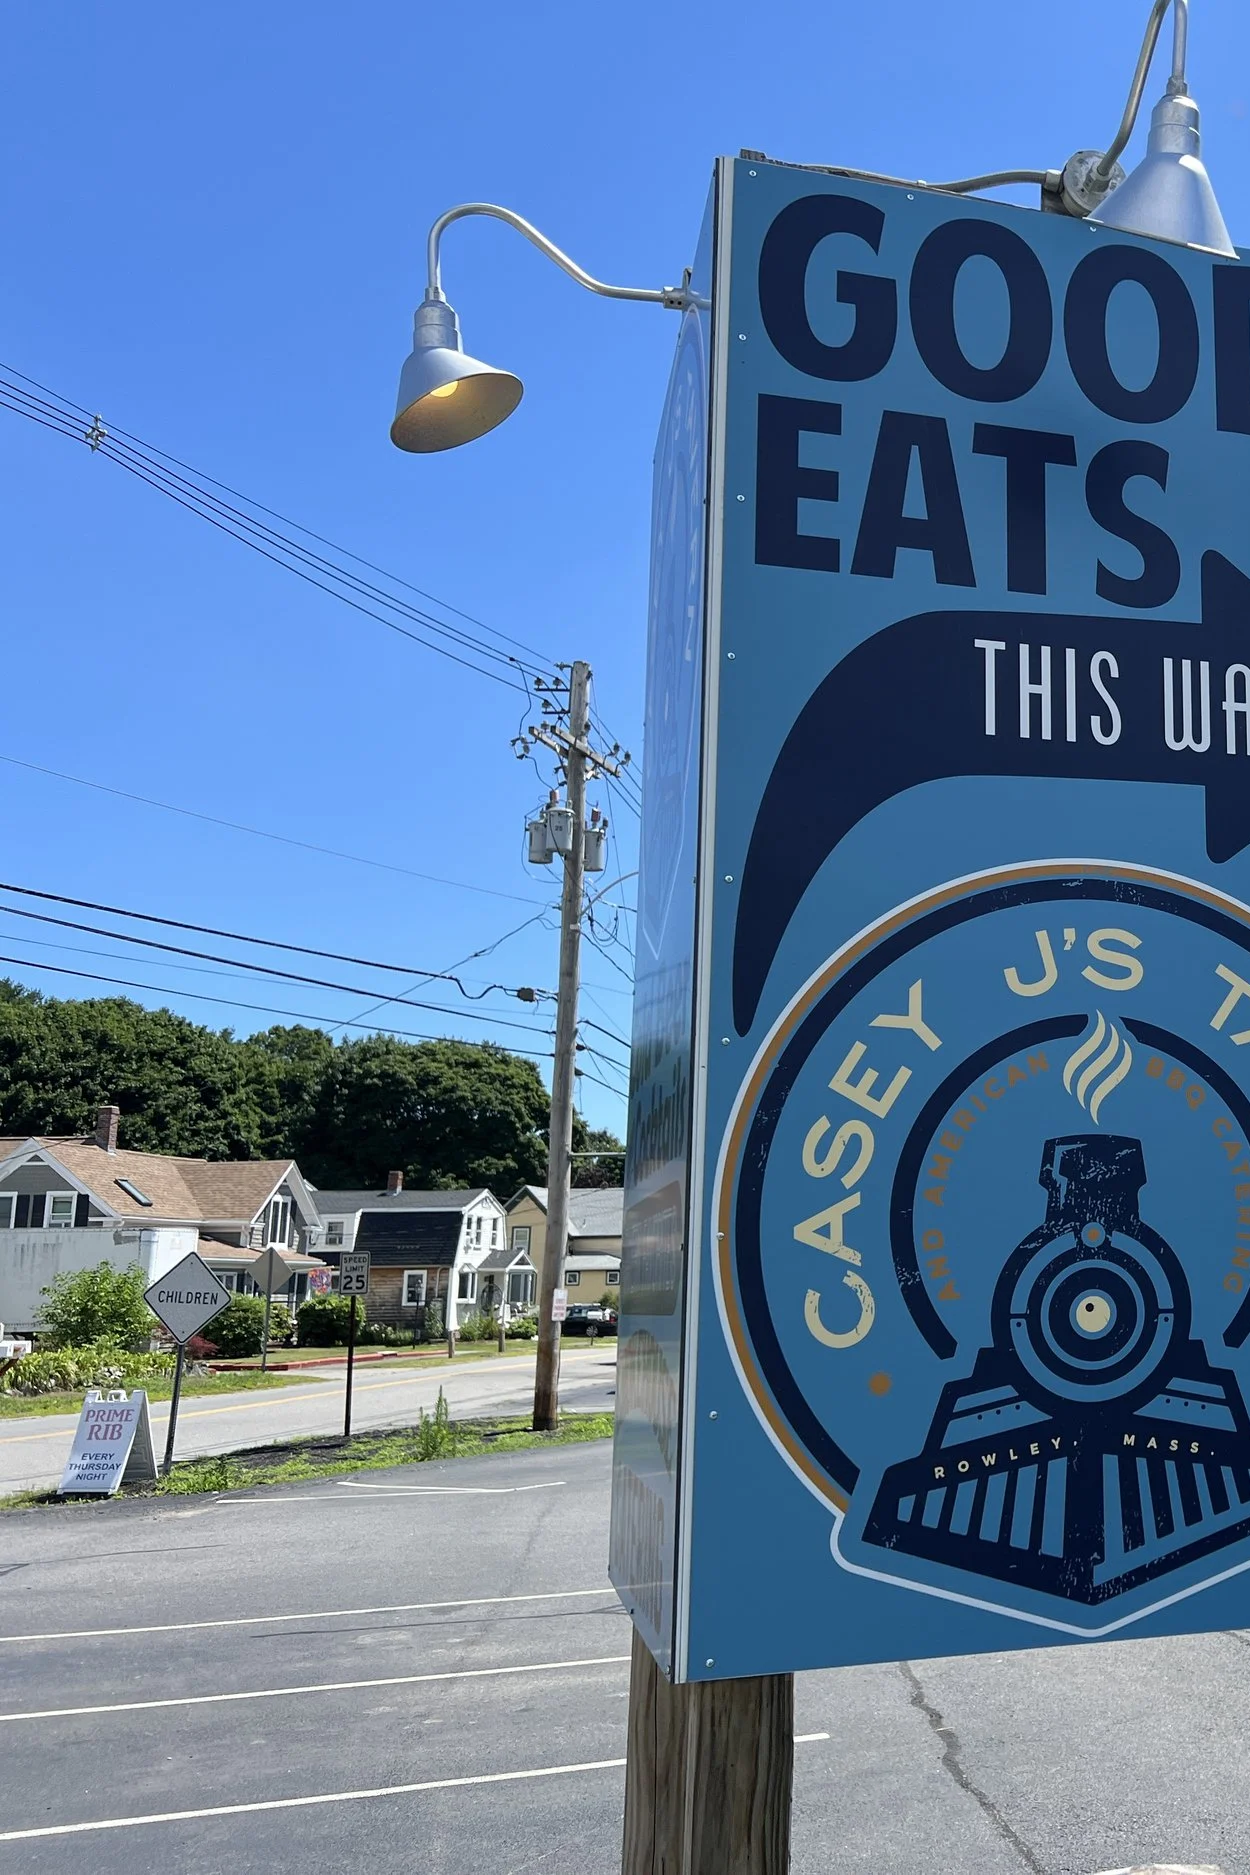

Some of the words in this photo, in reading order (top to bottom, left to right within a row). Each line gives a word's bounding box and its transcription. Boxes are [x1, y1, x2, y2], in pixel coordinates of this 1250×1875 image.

[754, 393, 1181, 608] EATS
[974, 638, 1122, 746] THIS
[1145, 1056, 1206, 1111] BBQ
[793, 978, 943, 1349] CASEY
[1003, 927, 1144, 997] J'S
[924, 1050, 1050, 1207] AMERICAN
[343, 1275, 365, 1290] 25
[922, 1229, 961, 1300] AND
[158, 1290, 218, 1305] CHILDREN
[85, 1409, 135, 1422] PRIME
[86, 1424, 123, 1441] RIB
[934, 1437, 1078, 1479] ROWLEY,
[1123, 1433, 1215, 1456] MASS.
